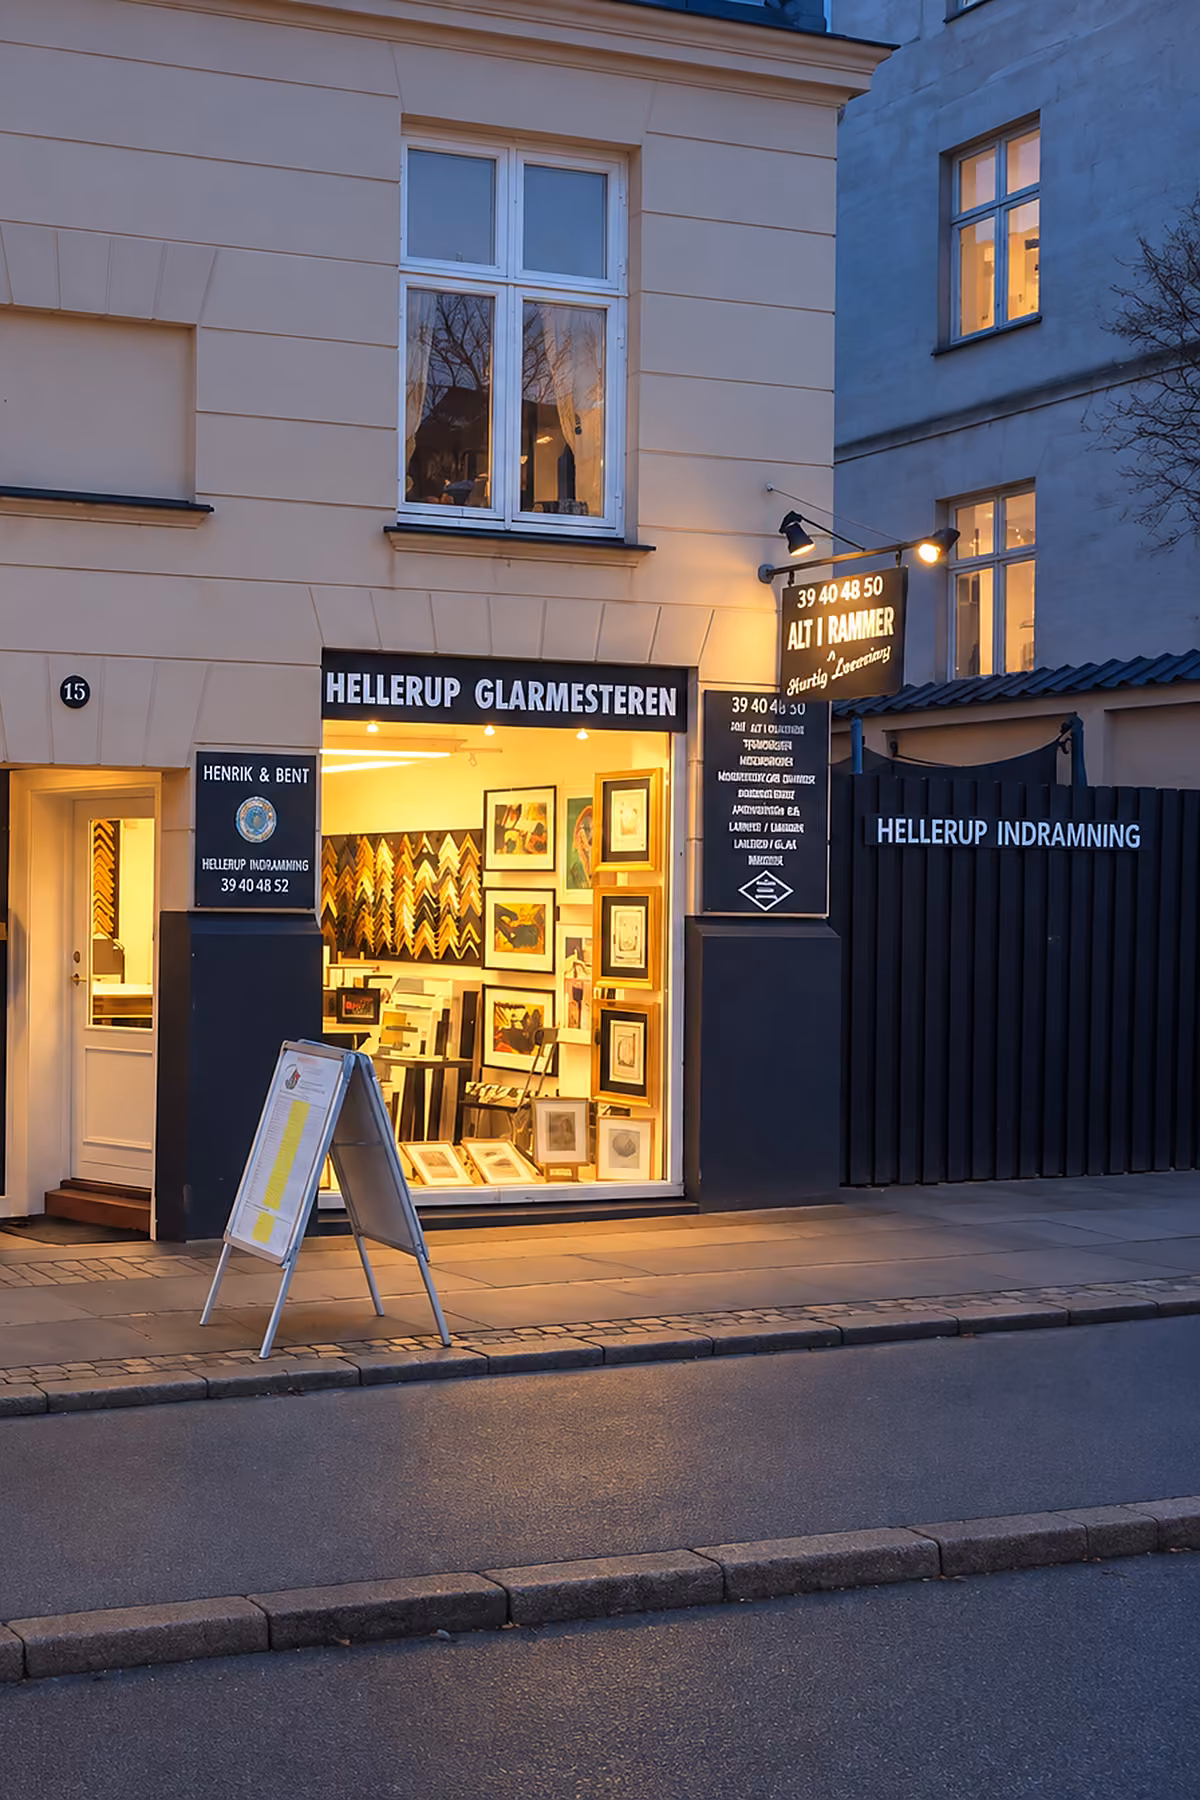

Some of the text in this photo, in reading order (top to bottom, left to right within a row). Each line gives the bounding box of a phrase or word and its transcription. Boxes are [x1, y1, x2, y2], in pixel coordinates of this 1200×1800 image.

[797, 576, 884, 608] 39 40 48 50
[787, 606, 895, 650] ALT I RAMMER
[64, 682, 86, 701] 15
[326, 671, 677, 717] HELLERUP GLARMESTEREN
[731, 696, 748, 714] 39
[750, 697, 768, 714] 40
[203, 764, 310, 784] HENRIK & BENT
[878, 817, 1141, 849] HELLERUP INDRAMNING
[202, 858, 247, 871] HELLERUP
[220, 877, 289, 893] 39 40 48 52
